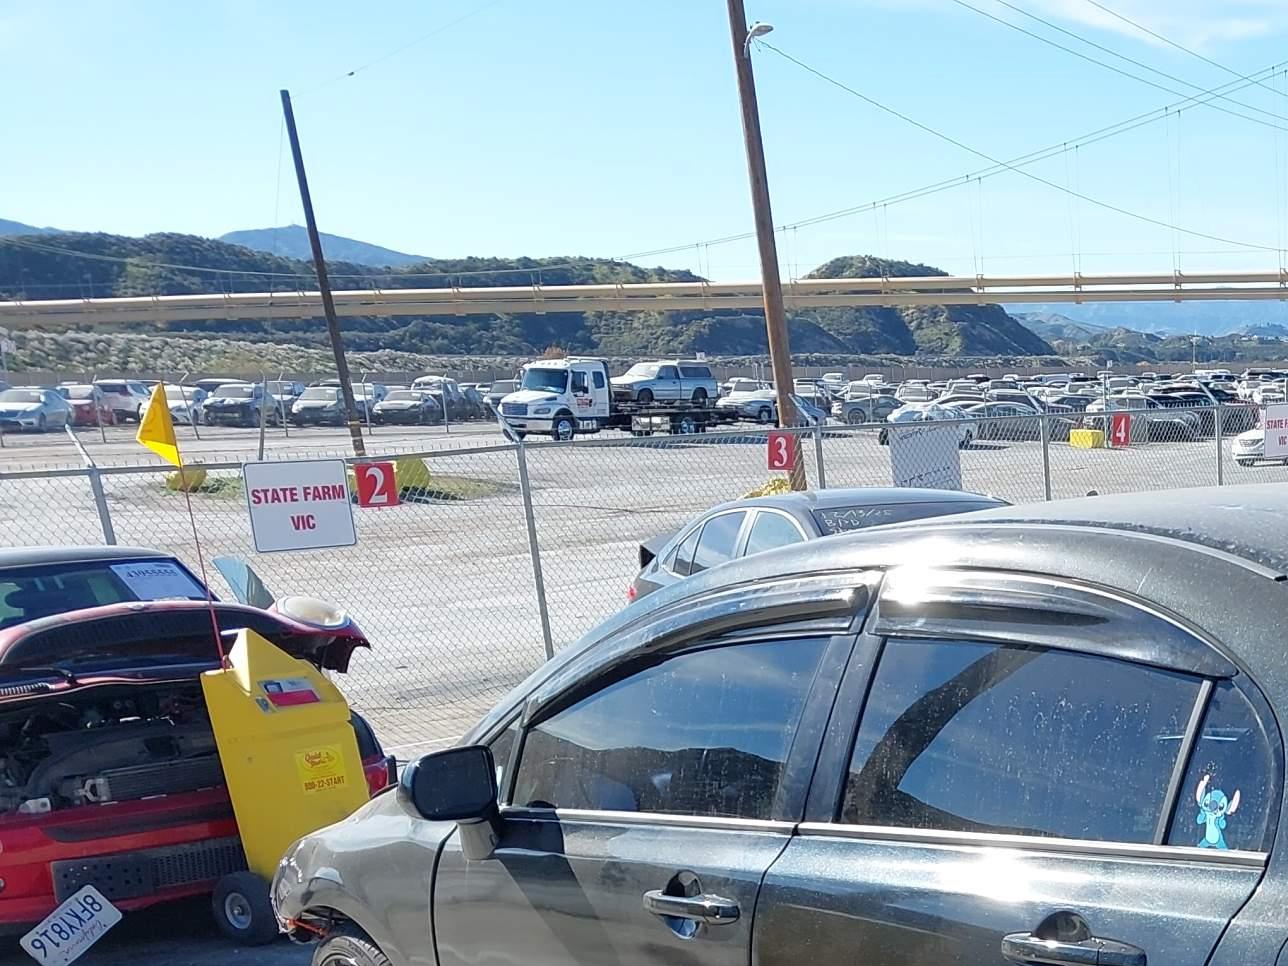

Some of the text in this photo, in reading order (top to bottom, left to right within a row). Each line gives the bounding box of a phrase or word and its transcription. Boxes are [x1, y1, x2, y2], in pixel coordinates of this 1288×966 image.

[1115, 416, 1126, 443] 4
[1266, 419, 1284, 430] STATE
[773, 436, 788, 467] 3
[251, 484, 345, 505] STATE FARM
[365, 466, 388, 504] 2
[290, 514, 316, 531] VIC
[31, 894, 103, 959] 8FKY816
